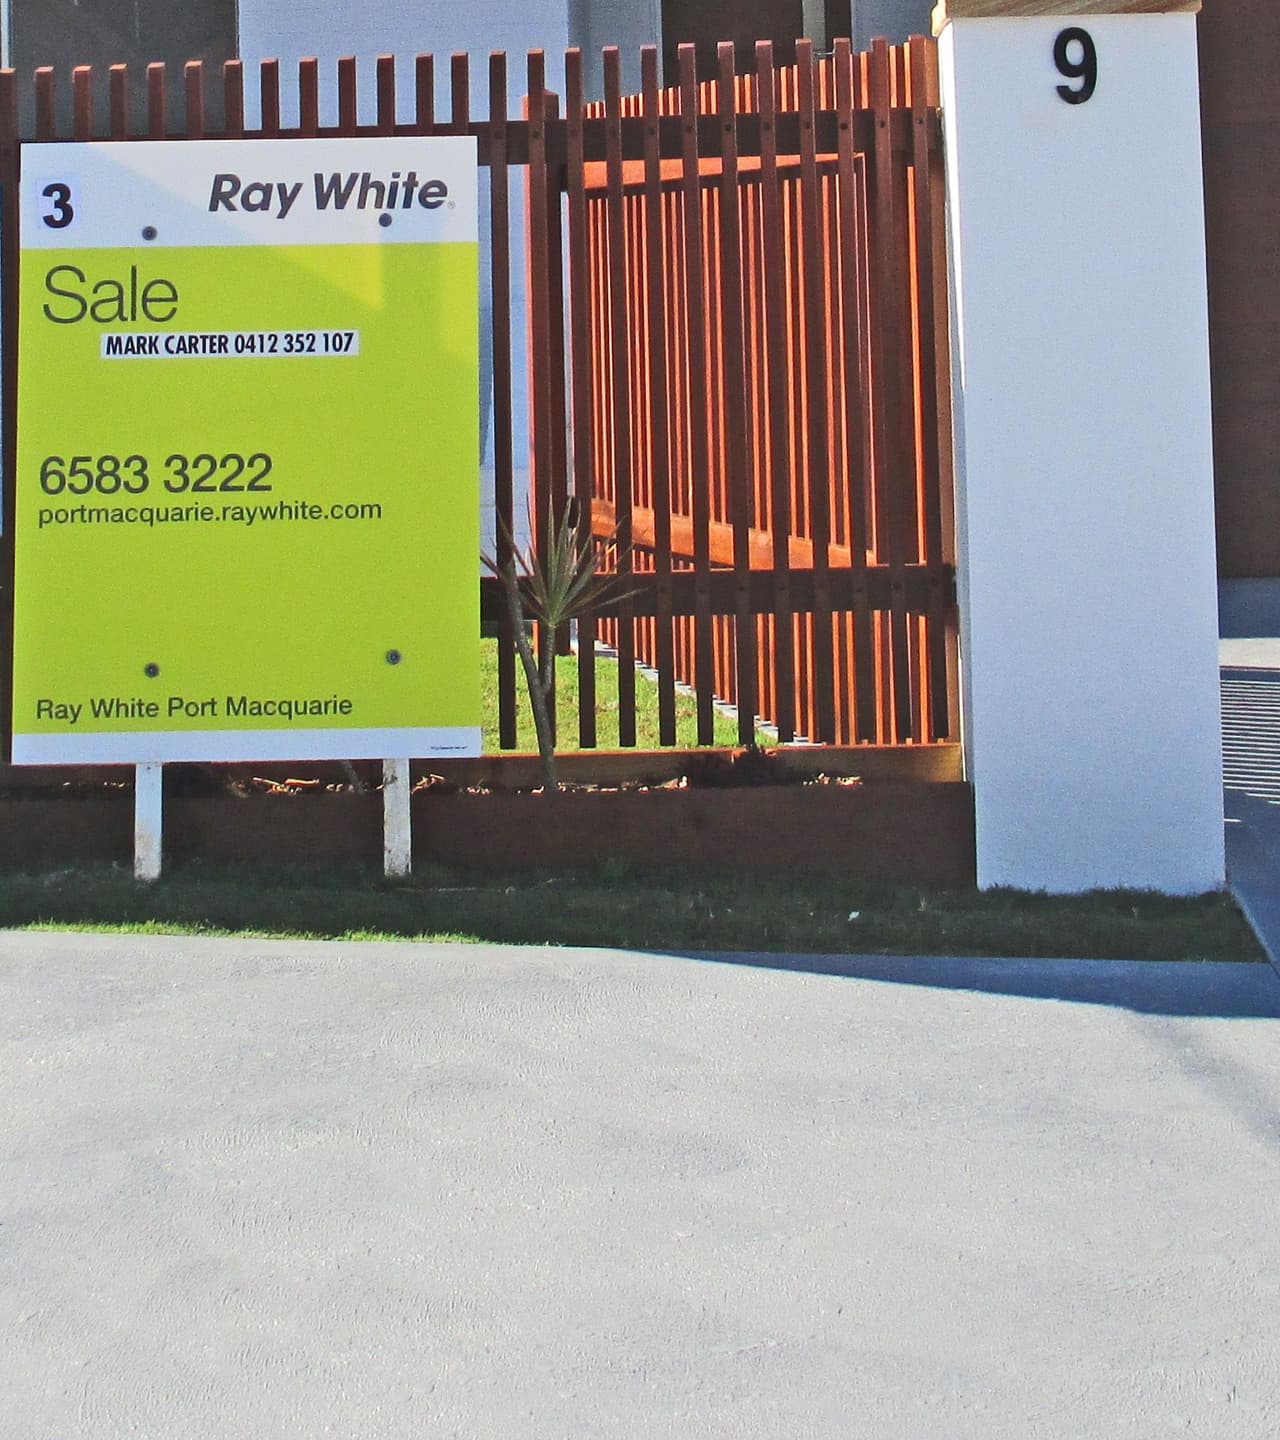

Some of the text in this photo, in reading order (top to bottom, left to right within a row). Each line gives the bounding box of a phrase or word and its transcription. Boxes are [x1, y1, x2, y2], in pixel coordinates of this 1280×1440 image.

[1053, 26, 1098, 105] 9
[41, 182, 75, 229] 3
[208, 170, 449, 220] Ray White
[42, 264, 180, 324] Sale
[105, 332, 354, 356] MARK CARTER 0412 352 107
[38, 452, 274, 496] 6583 3222
[37, 499, 383, 529] portmacquarie.raywhite.com
[35, 694, 354, 725] Ray White Port Macquarie
